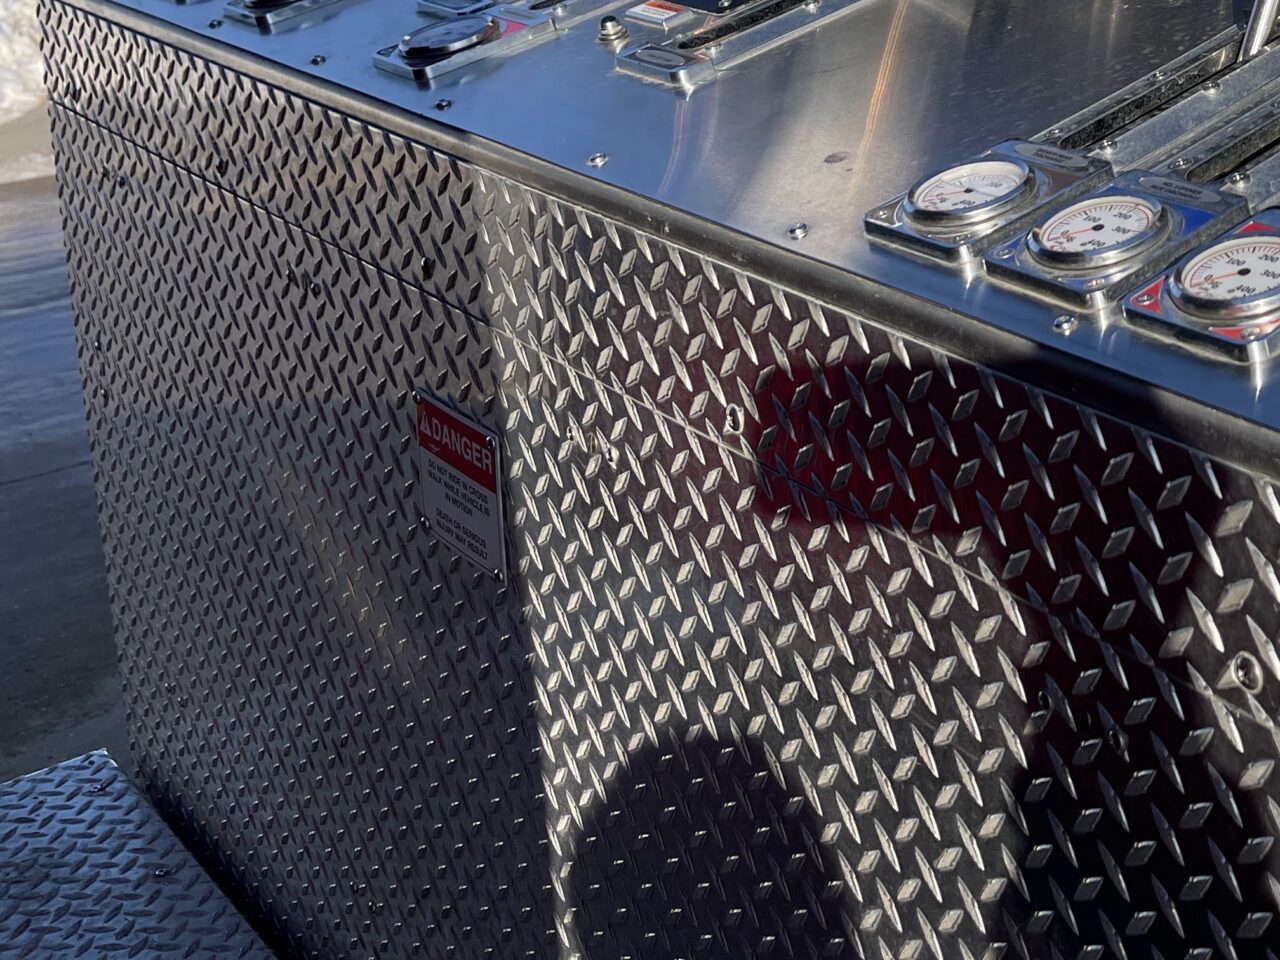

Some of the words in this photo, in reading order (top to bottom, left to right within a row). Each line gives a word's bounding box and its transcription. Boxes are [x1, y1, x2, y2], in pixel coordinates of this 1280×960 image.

[1083, 215, 1101, 223] 100
[1112, 212, 1132, 220] 200
[1111, 225, 1131, 234] 300
[1088, 239, 1106, 247] 400
[1226, 257, 1246, 266] 100
[1257, 254, 1279, 263] 200
[1260, 269, 1280, 279] 300
[1235, 284, 1256, 293] 400
[431, 416, 492, 475] DANGER
[436, 463, 447, 478] NOT
[448, 470, 461, 487] RIDE
[468, 484, 488, 505] CROSS
[428, 469, 442, 486] WALK
[443, 478, 460, 497] WHILE
[460, 490, 483, 513] VEHICLE
[451, 495, 472, 517] MOTION
[435, 506, 452, 525] DEATH
[453, 518, 461, 532] OR
[462, 524, 486, 549] SERIOUS
[435, 517, 453, 537] INJURY
[454, 530, 466, 546] MAY
[467, 538, 488, 562] RESULT
